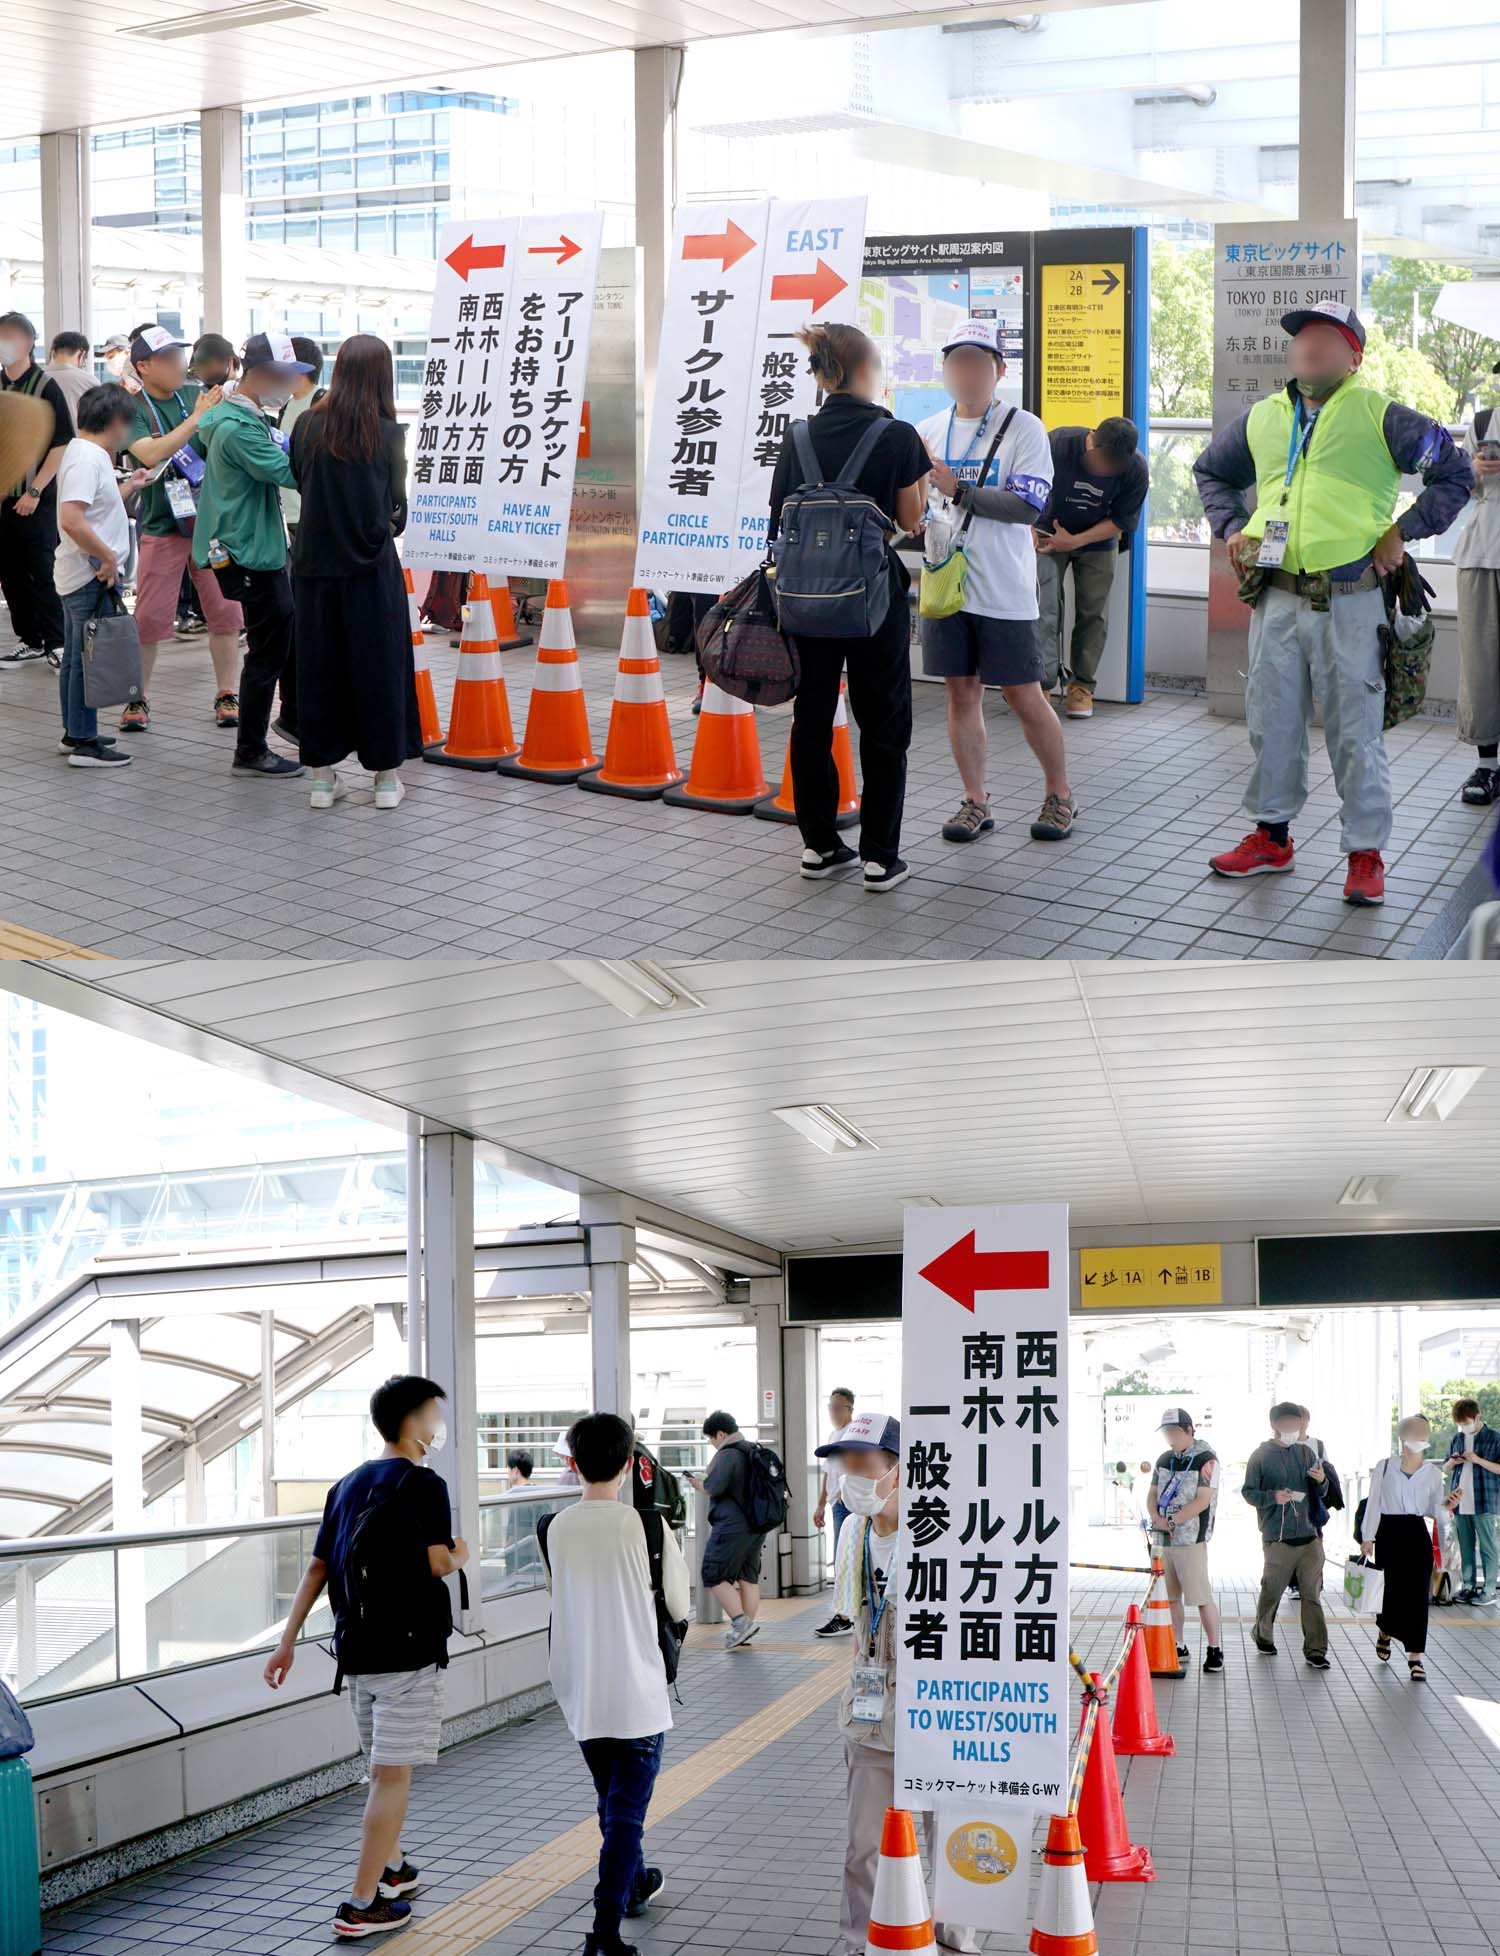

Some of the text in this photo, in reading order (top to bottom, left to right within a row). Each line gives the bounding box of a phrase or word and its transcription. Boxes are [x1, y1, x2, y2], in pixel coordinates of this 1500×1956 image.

[786, 227, 844, 253] EAST
[1225, 241, 1346, 263] 東京ビッグサイト
[1069, 270, 1084, 281] 2A
[1069, 285, 1083, 296] 2B
[1226, 289, 1347, 305] TOKYO BIG SIGHT
[438, 293, 480, 485] 南ホール方面
[463, 292, 505, 485] 西ホール方面
[498, 292, 546, 484] をお持ちの方
[540, 292, 584, 487] アーリーチケット
[668, 289, 734, 497] サークル参加者
[1226, 378, 1260, 392] 도쿄
[414, 337, 450, 485] 一般参加者
[416, 494, 477, 510] PARTICIPANTS
[502, 503, 551, 518] HAVE AN
[411, 511, 479, 526] TO WEST/SOUTH
[487, 519, 563, 537] EARLY TICKET
[667, 513, 709, 528] CIRCLE
[429, 529, 456, 543] HALLS
[642, 530, 729, 549] PARTICIPANTS
[738, 536, 754, 550] TO
[1125, 1269, 1211, 1284] 1A 1B
[958, 1330, 1006, 1662] 南ホール方面
[1012, 1330, 1061, 1663] 西ホール方面
[903, 1405, 952, 1661] 一般参加者
[916, 1679, 1049, 1704] PARTICIPANTS
[907, 1708, 1058, 1735] TO WEST/SOUTH
[952, 1740, 1011, 1763] HALLS
[904, 1778, 1061, 1797] コミックマーケット準備会 G-WY
